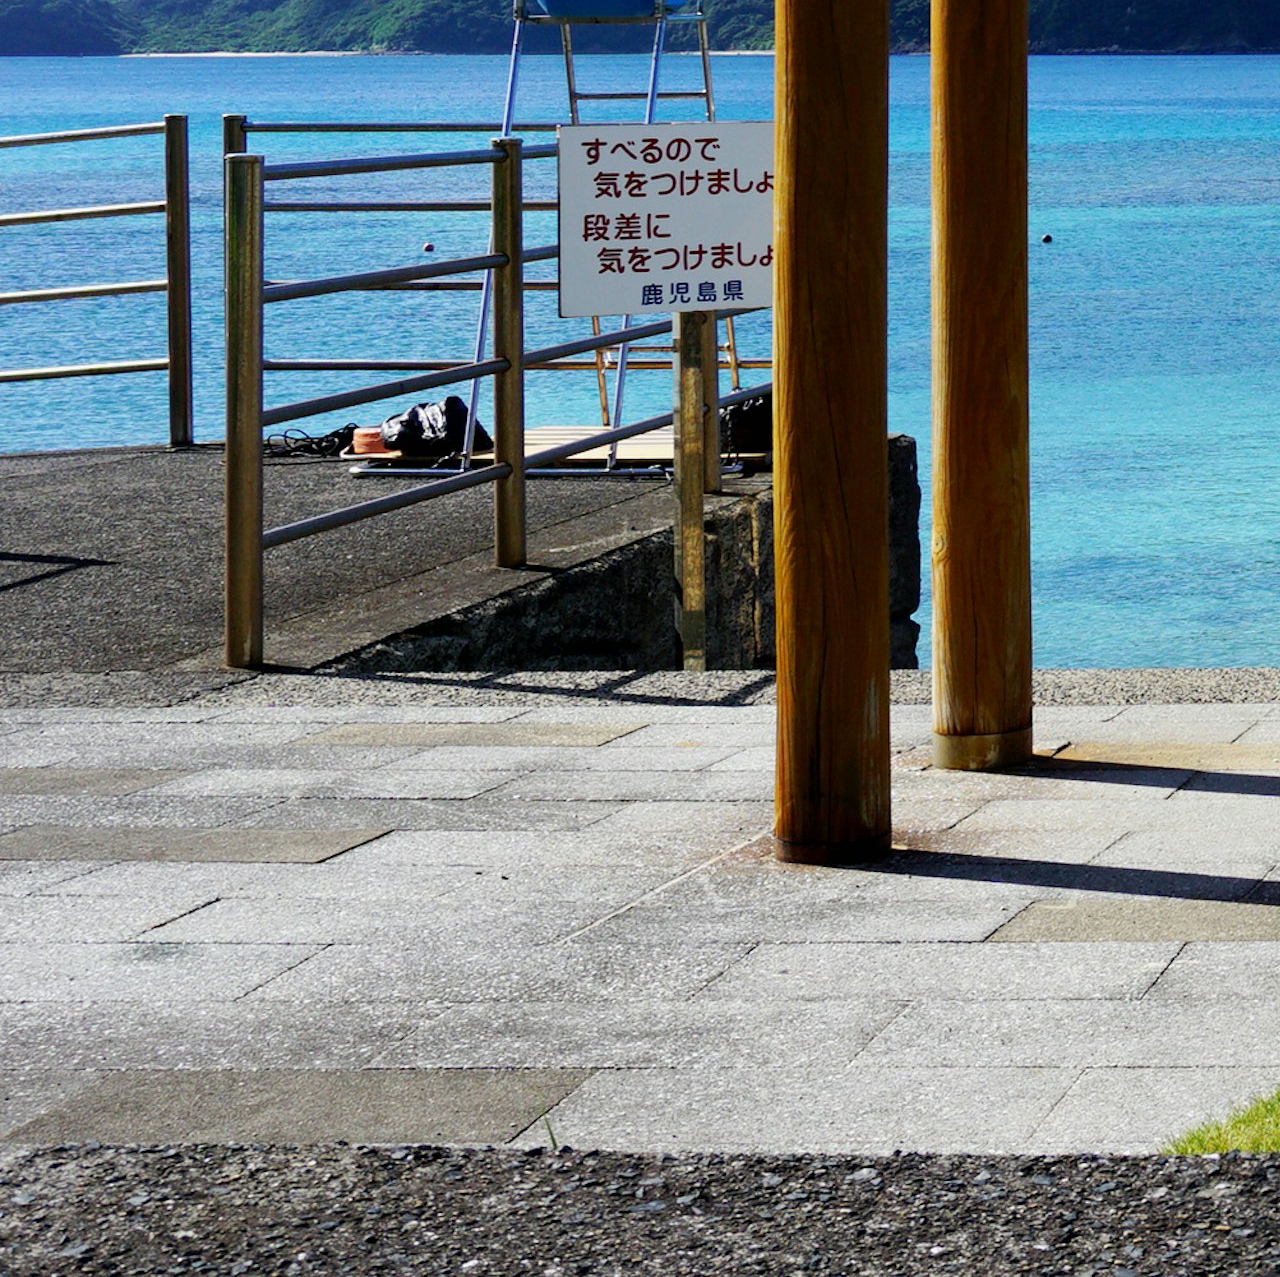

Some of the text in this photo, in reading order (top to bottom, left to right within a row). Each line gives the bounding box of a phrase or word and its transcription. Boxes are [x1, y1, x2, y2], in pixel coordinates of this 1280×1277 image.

[581, 138, 720, 165] すべるので
[582, 213, 671, 241] 段差に
[641, 280, 744, 306] 鹿児島県
